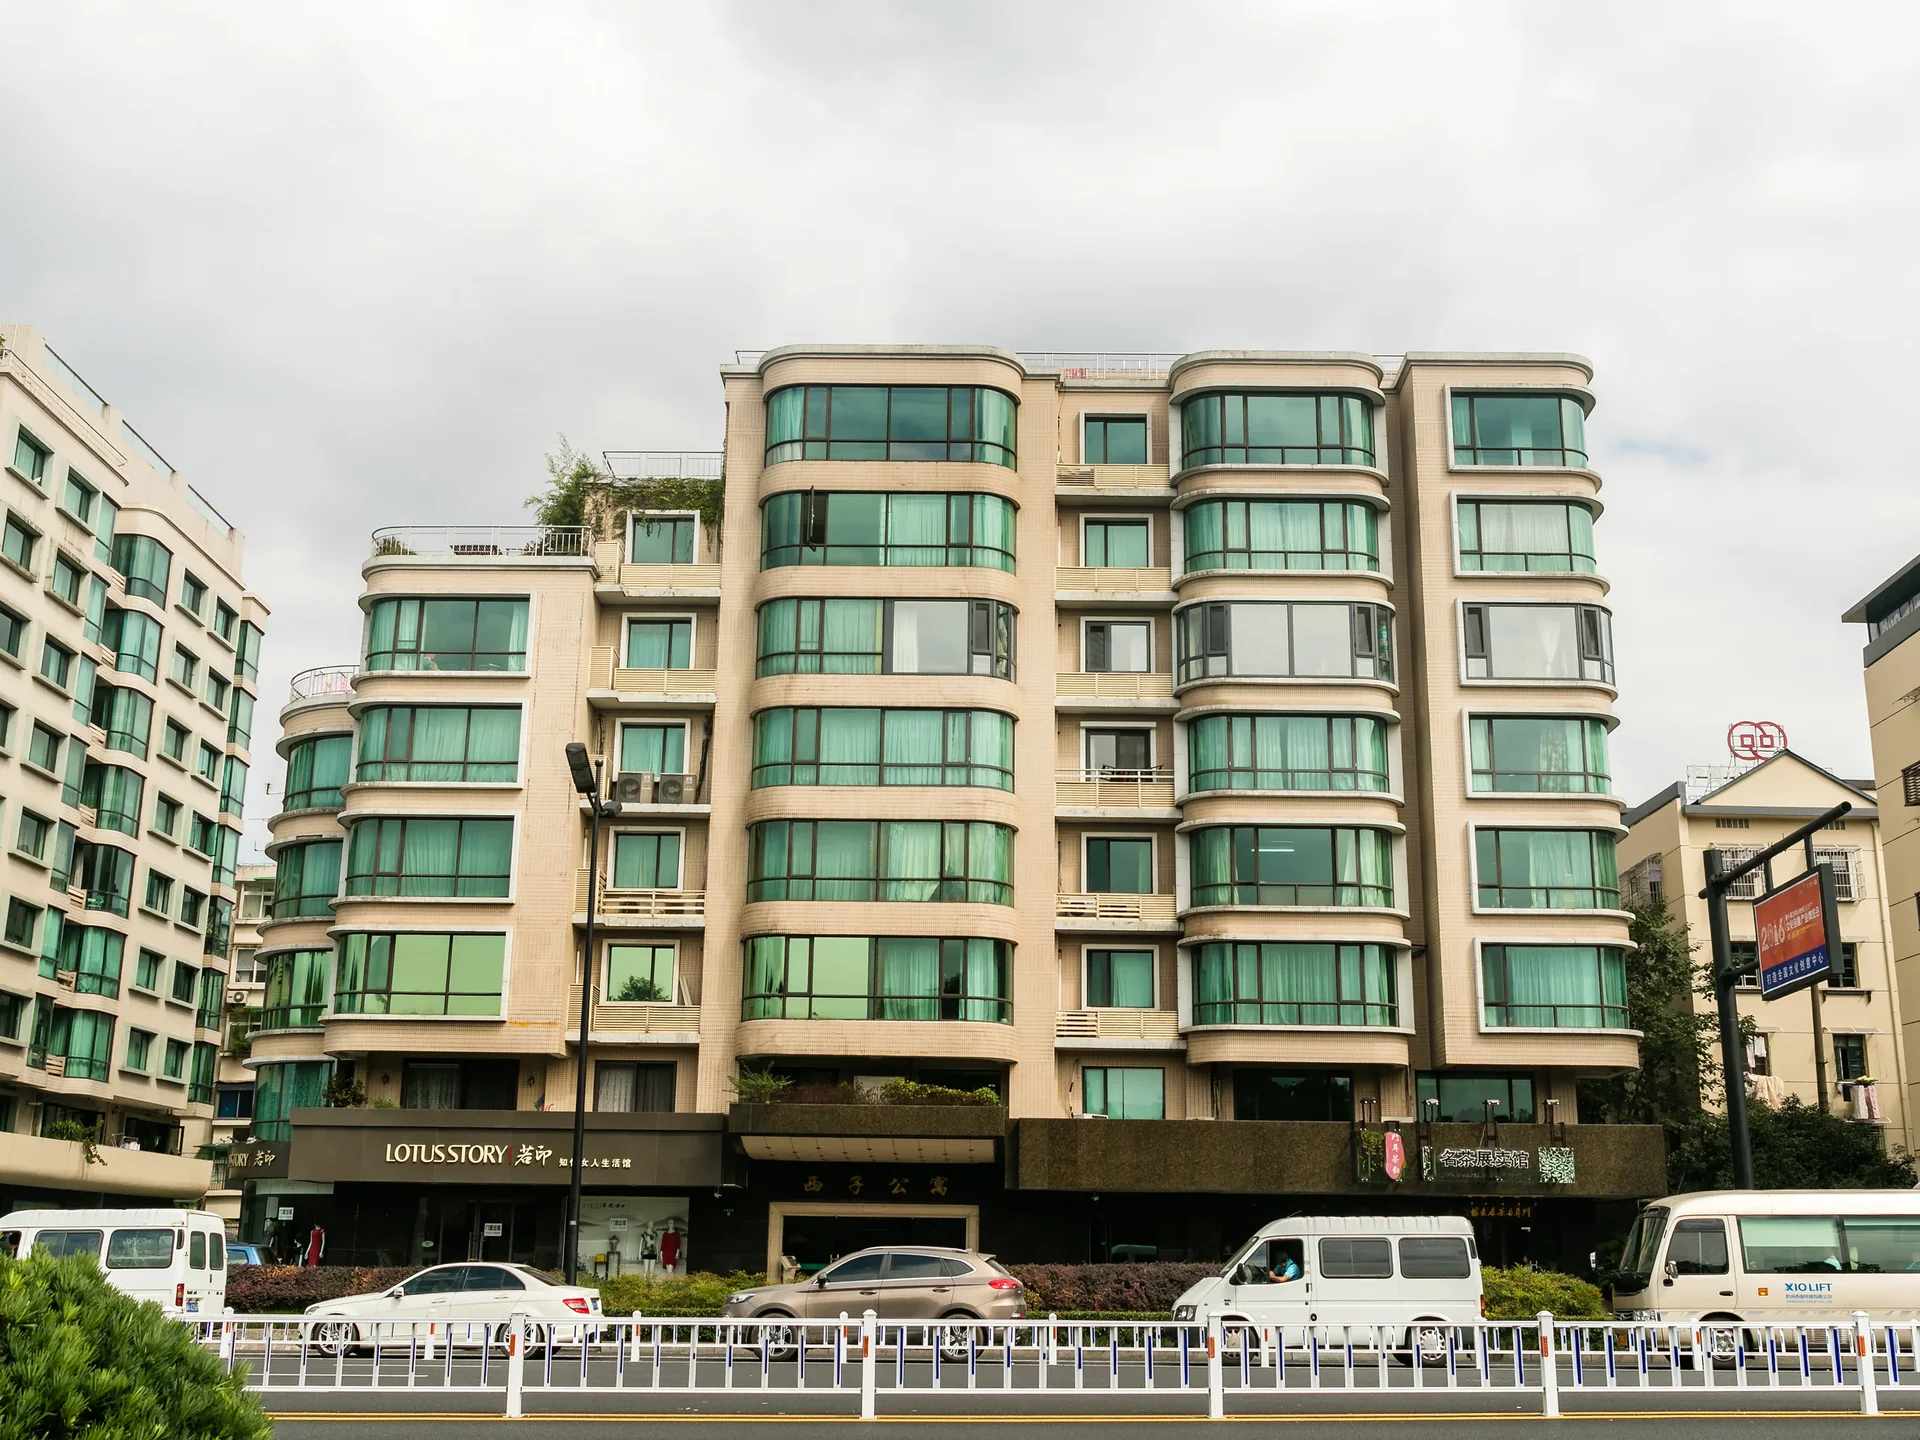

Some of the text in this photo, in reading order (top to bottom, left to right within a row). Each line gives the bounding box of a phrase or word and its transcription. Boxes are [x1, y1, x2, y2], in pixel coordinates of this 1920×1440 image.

[1760, 917, 1786, 952] 2016
[1439, 1148, 1530, 1169] 名茶展卖馆
[803, 1175, 949, 1197] 西子公寓
